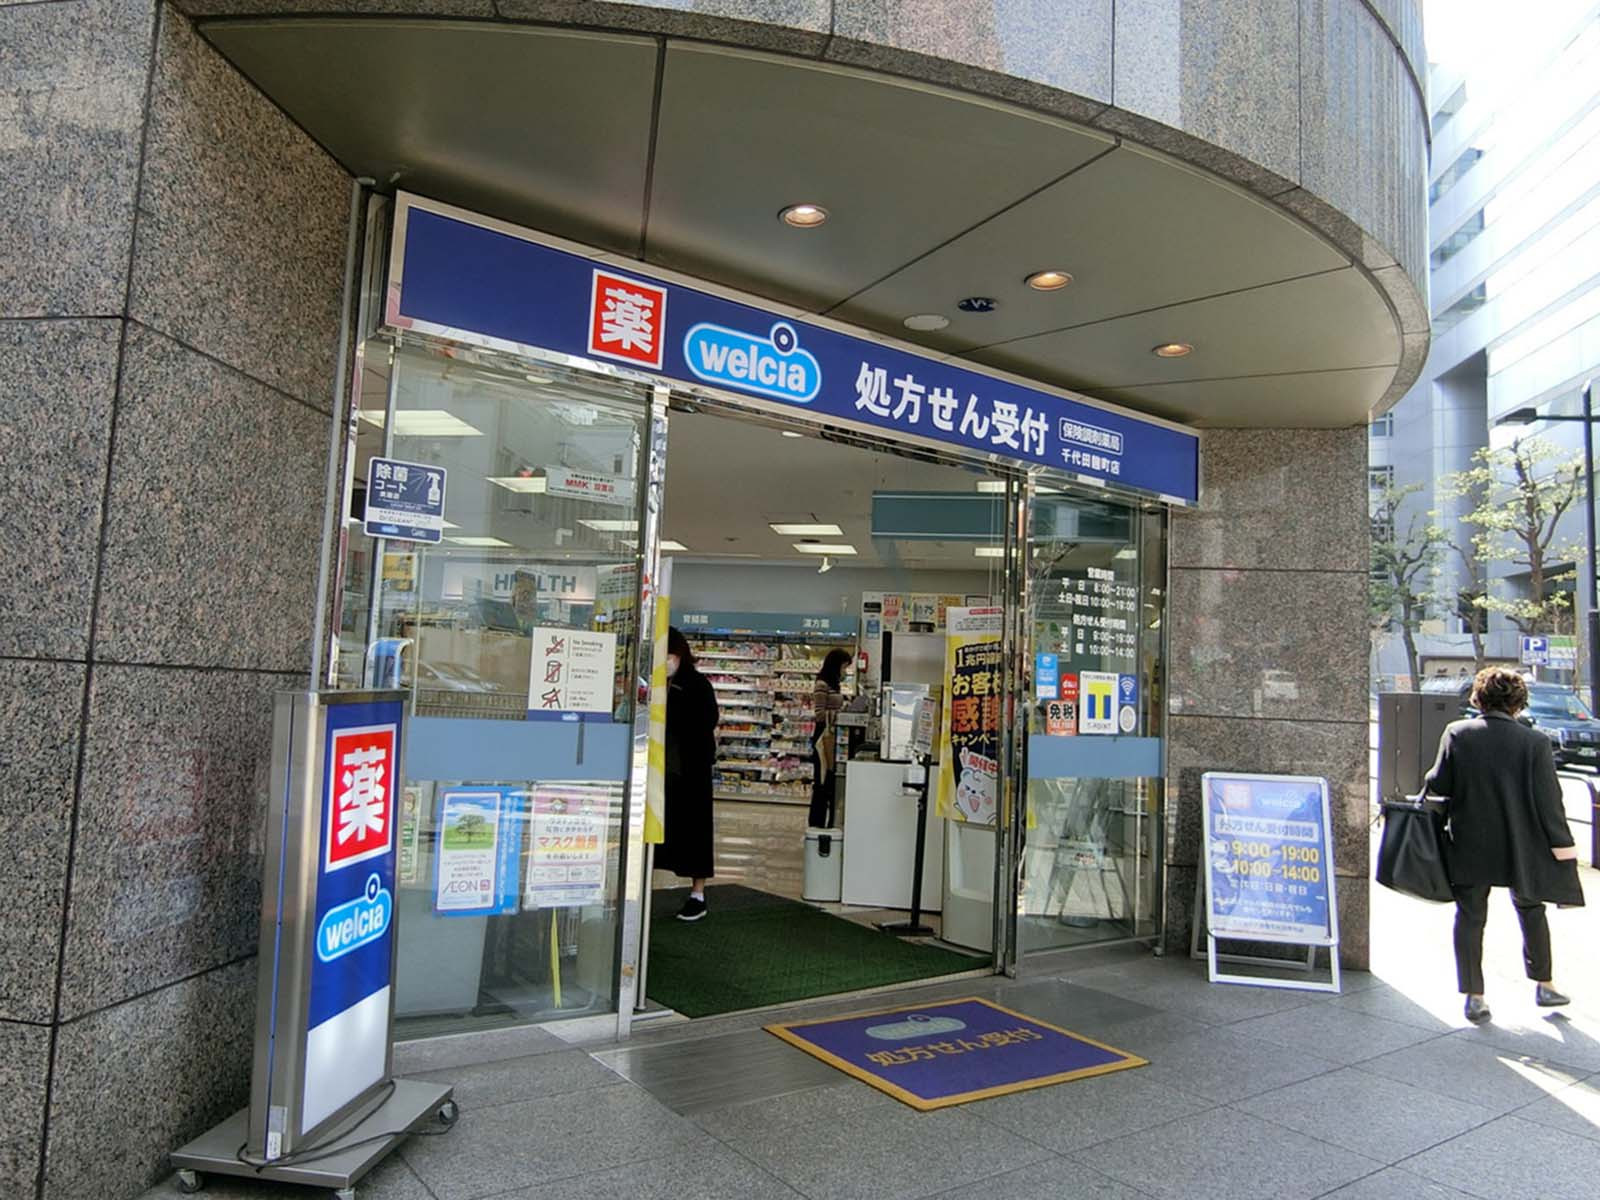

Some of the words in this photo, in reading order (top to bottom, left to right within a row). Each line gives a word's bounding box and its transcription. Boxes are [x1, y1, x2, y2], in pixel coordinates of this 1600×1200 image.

[600, 287, 654, 354] 薬
[698, 339, 807, 394] welcia
[855, 361, 1049, 456] 処方せん受付
[374, 480, 407, 493] コート
[376, 463, 408, 482] 除菌
[495, 573, 577, 593] HLTH
[1050, 703, 1074, 720] 免税
[952, 733, 998, 746] キャンペー
[339, 747, 385, 845] 薬
[326, 904, 384, 951] welcia
[864, 1027, 1043, 1066] 処方せん受付
